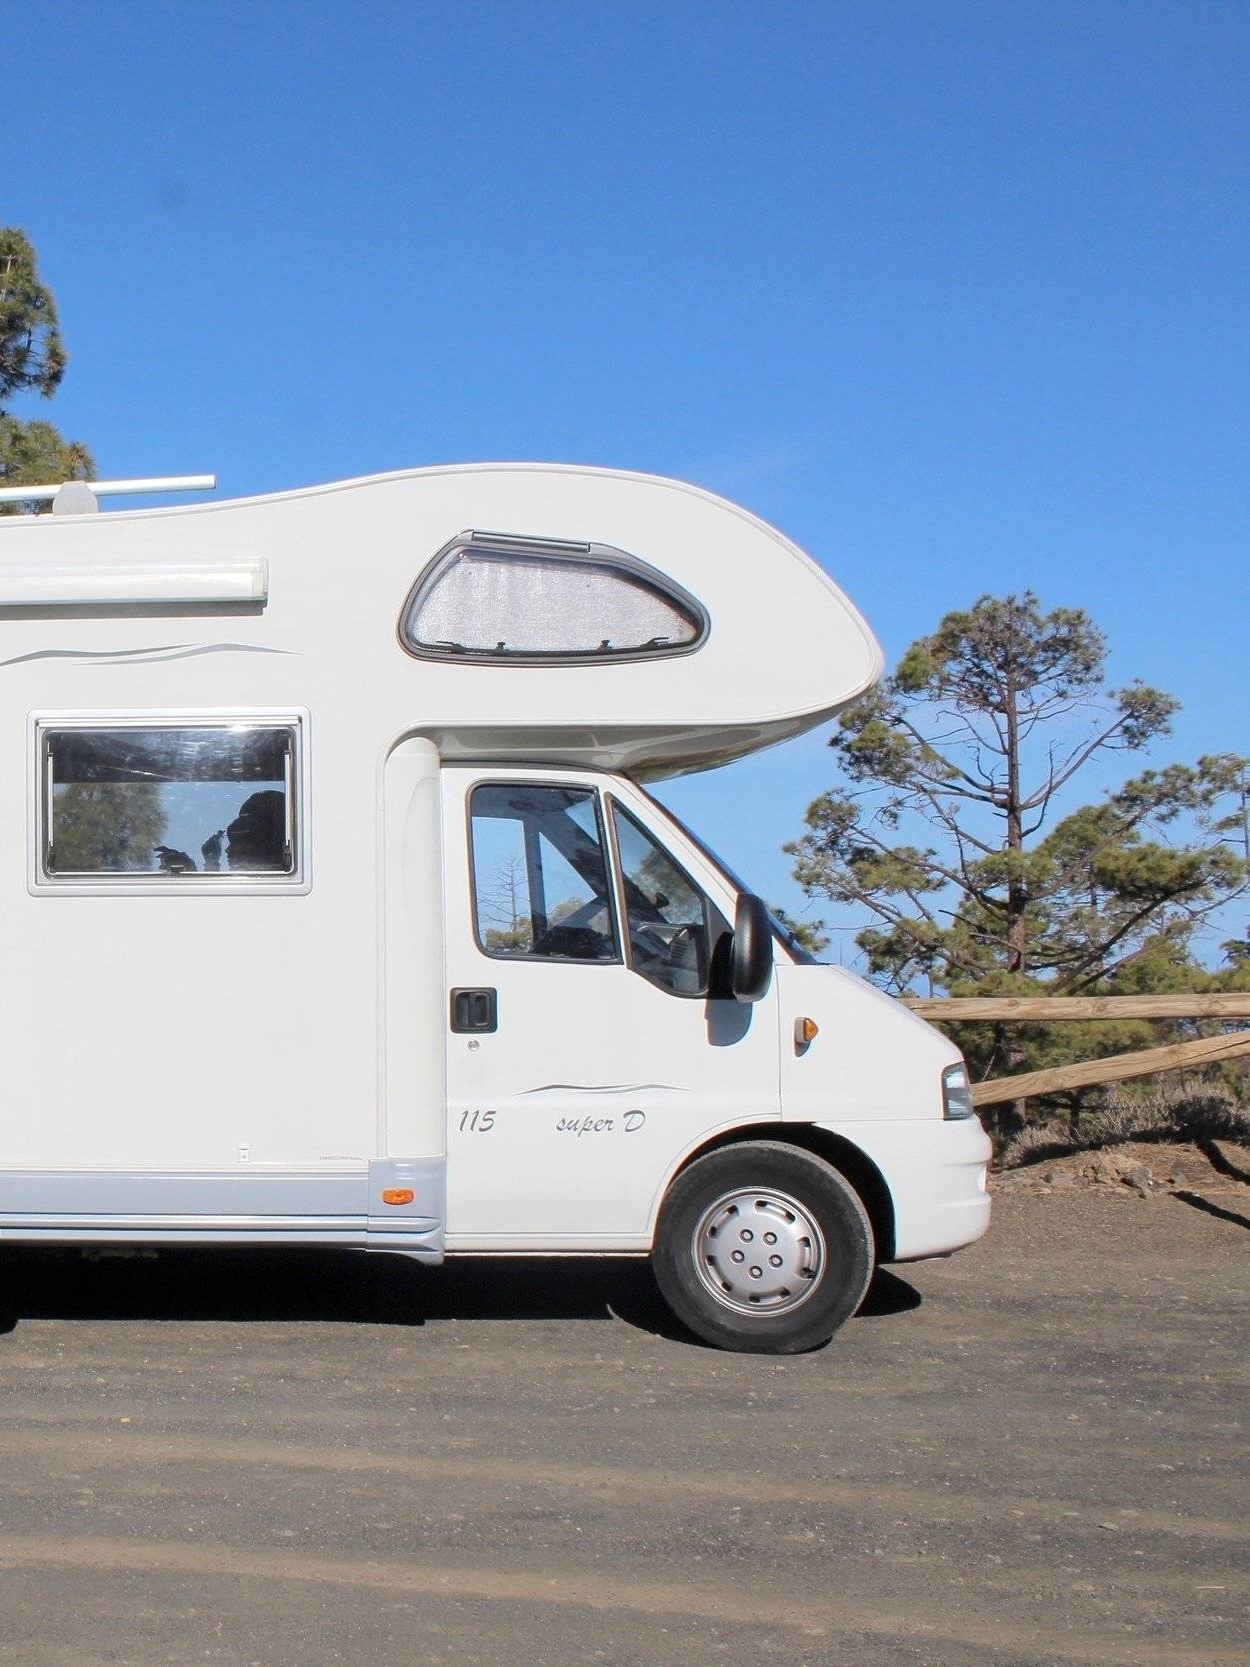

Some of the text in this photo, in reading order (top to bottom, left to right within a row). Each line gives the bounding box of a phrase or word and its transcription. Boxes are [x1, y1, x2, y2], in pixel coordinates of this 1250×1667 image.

[459, 1109, 497, 1132] 115
[555, 1109, 646, 1138] super D
